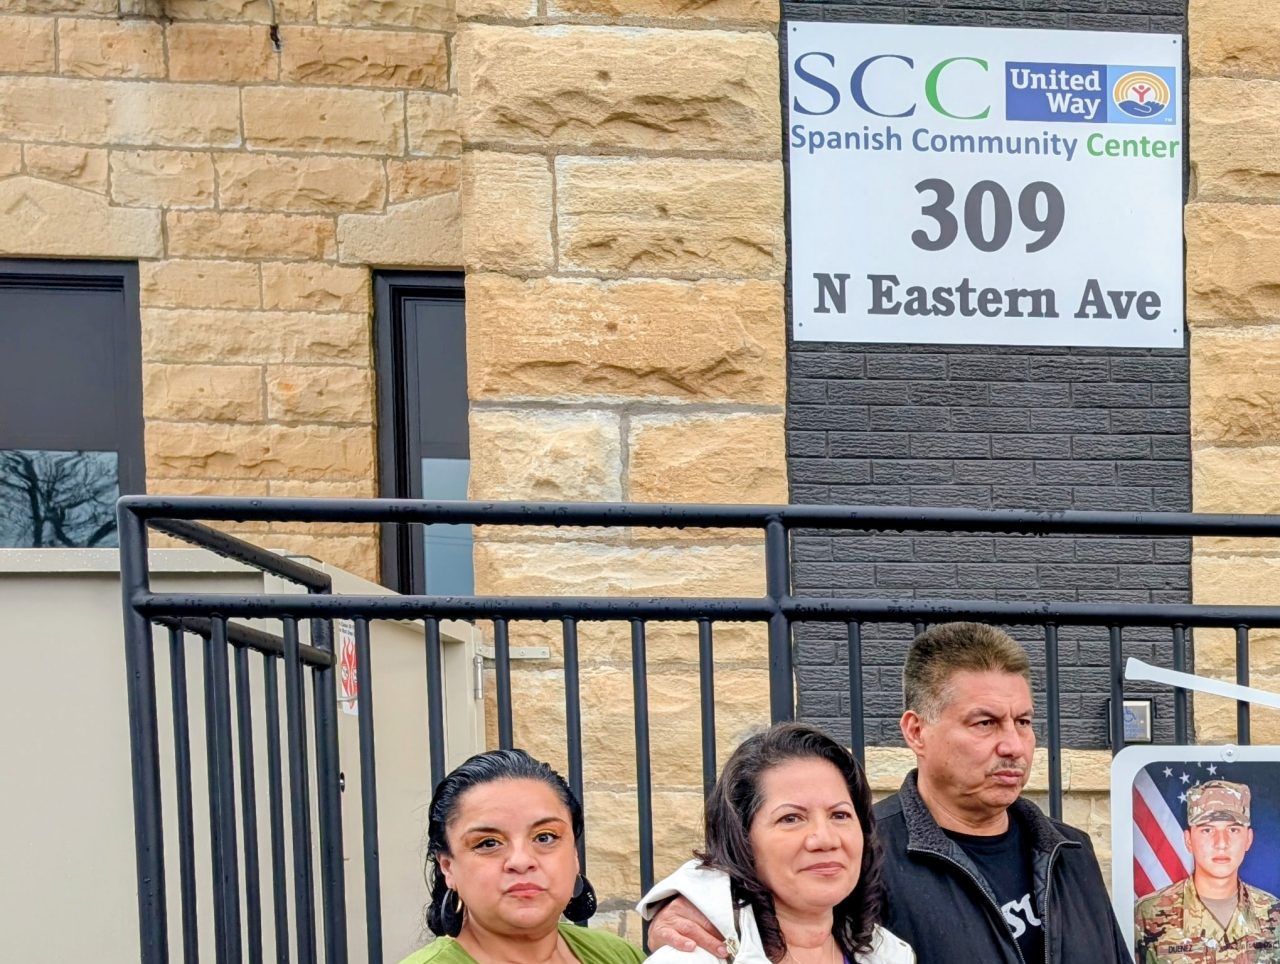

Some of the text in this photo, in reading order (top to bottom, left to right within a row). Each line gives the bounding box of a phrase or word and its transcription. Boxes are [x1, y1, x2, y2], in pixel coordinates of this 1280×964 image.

[793, 52, 991, 119] SCC
[1010, 68, 1102, 91] United
[1046, 93, 1101, 120] Way
[791, 124, 1180, 161] Spanish Community Center
[911, 178, 1066, 253] 309
[813, 273, 1162, 321] N Eastern Ave
